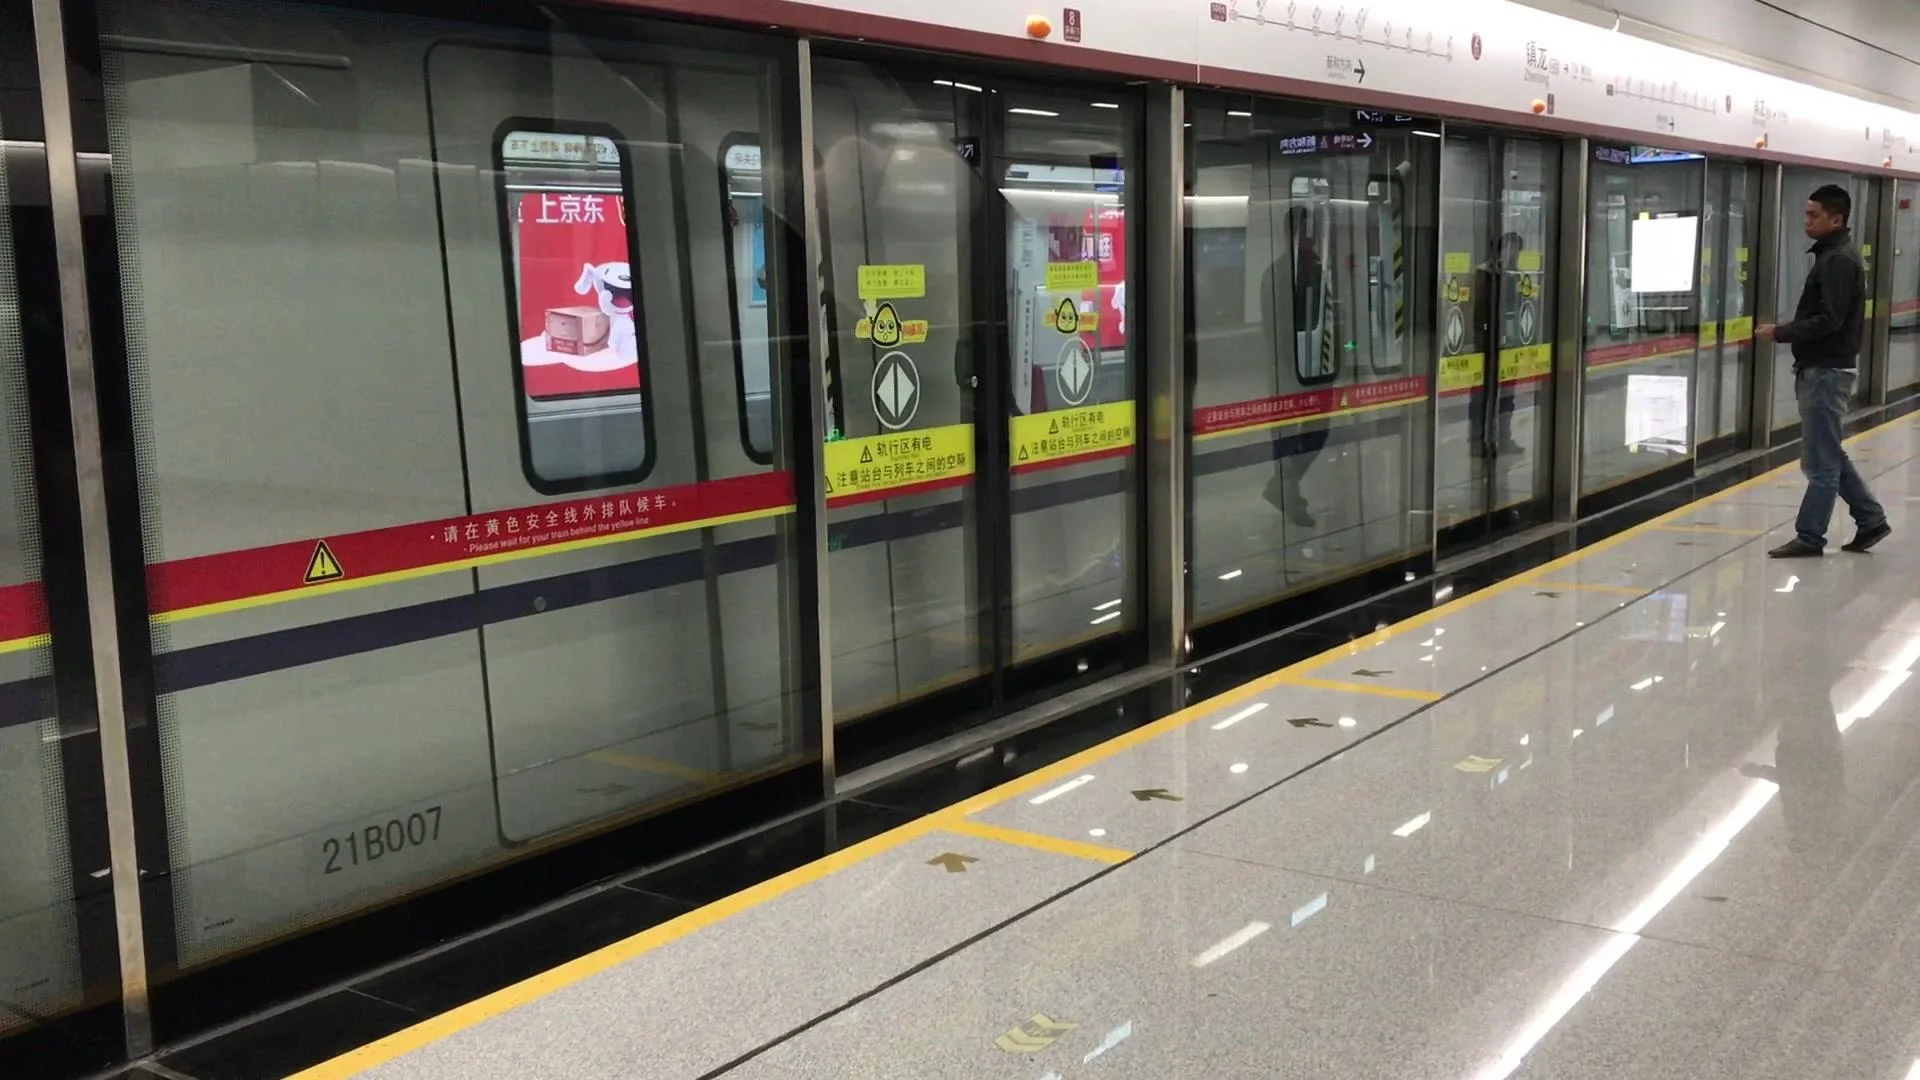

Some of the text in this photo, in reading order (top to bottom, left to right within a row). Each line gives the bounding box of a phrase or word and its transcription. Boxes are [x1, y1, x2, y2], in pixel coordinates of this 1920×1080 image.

[1068, 10, 1076, 26] 8
[536, 193, 605, 224] 上京东
[877, 436, 932, 457] 轨行区有电
[469, 516, 649, 553] Please wait for your train behind the yellow line
[323, 806, 442, 874] 21B007
